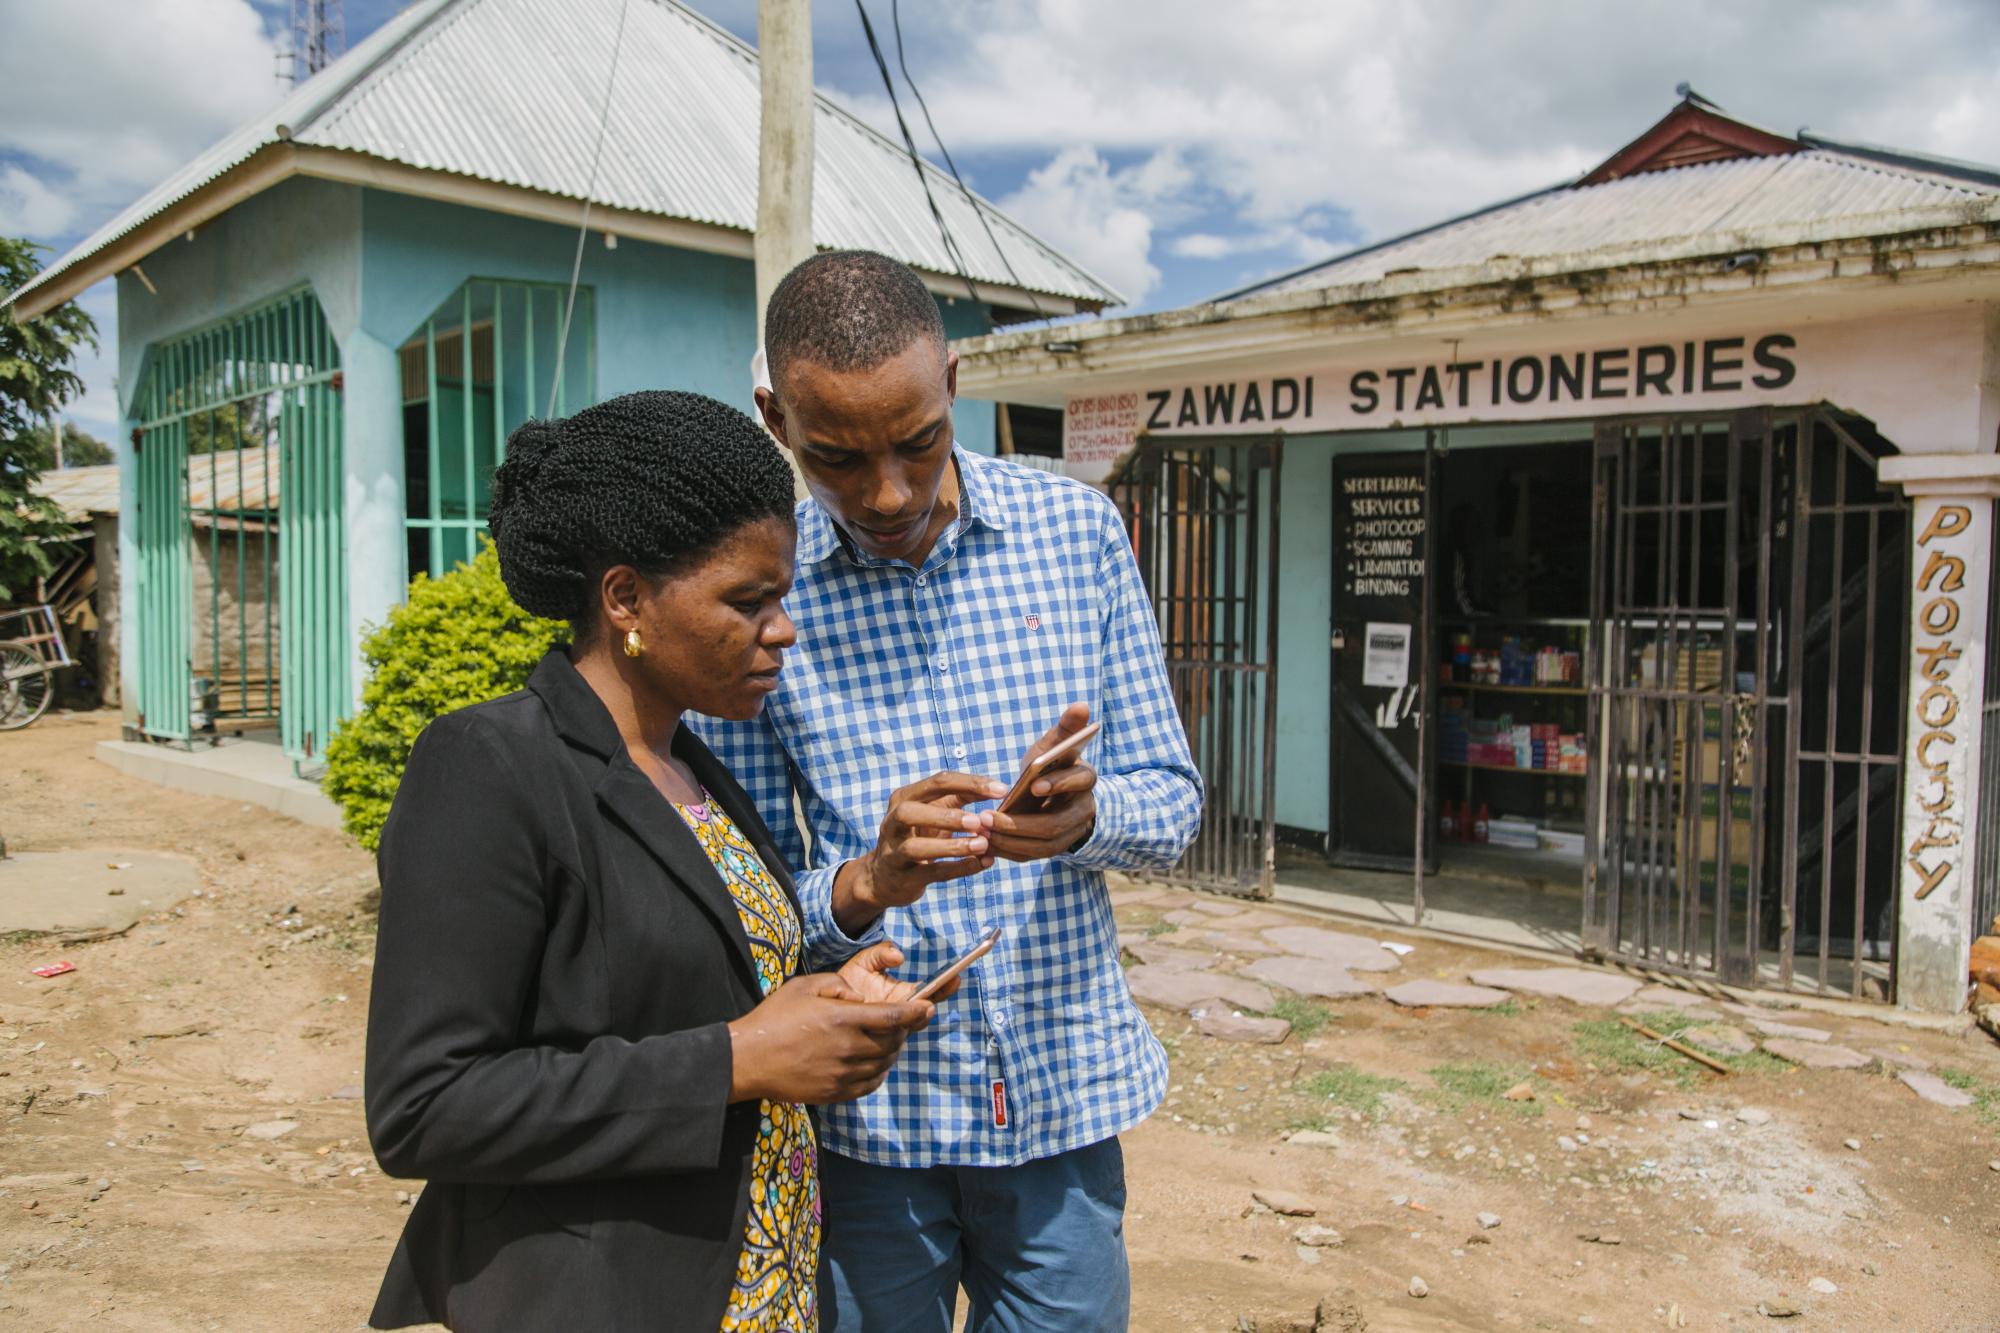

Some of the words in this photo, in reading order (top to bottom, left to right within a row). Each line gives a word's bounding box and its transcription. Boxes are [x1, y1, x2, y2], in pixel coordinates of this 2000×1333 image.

[1146, 376, 1314, 430] ZAWADI
[1349, 334, 1797, 414] STATIONERIES
[1351, 498, 1421, 516] SERVICES
[1353, 539, 1414, 557] SCANNING
[1354, 578, 1410, 596] BINDING
